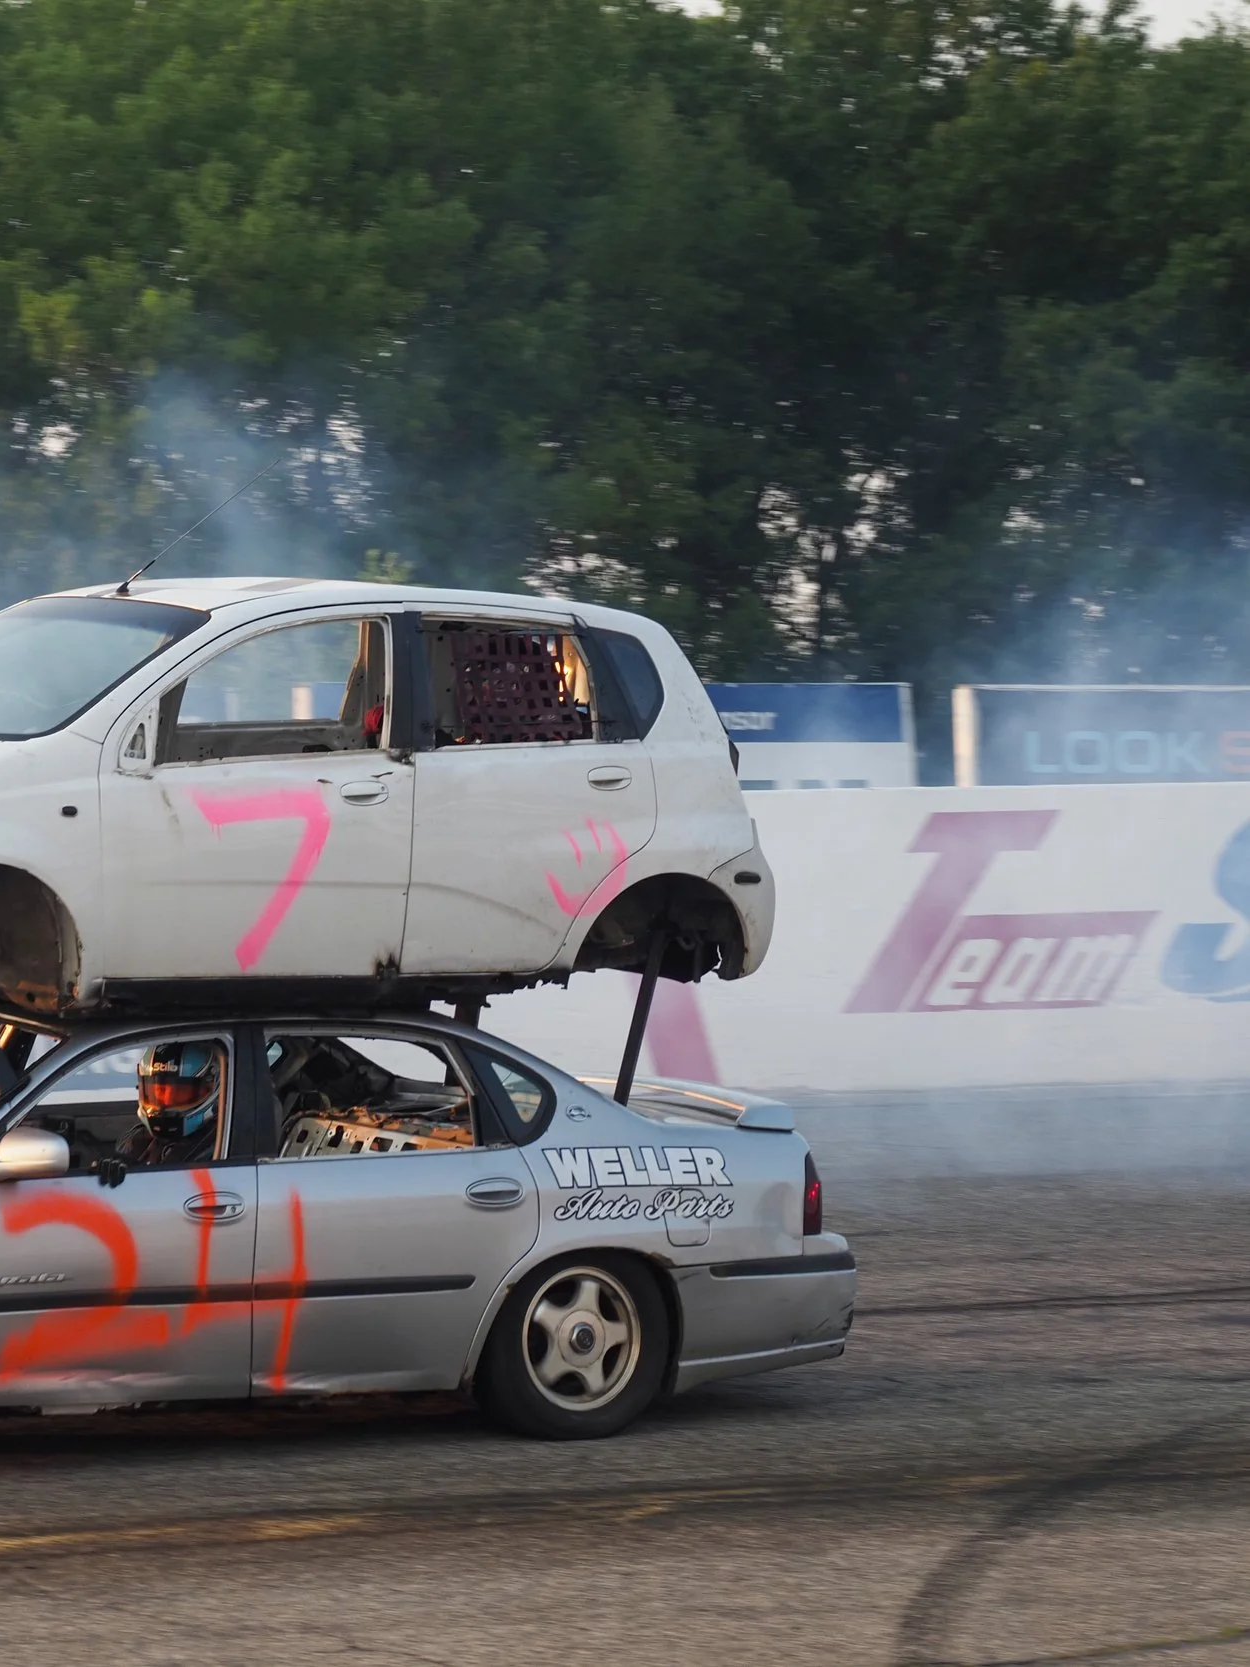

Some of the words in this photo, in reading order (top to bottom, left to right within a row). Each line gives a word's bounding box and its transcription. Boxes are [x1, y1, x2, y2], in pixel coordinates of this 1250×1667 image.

[1024, 730, 1210, 774] LOOK
[190, 786, 332, 973] 7
[541, 1146, 734, 1189] WELLER
[554, 1188, 641, 1221] Auto
[644, 1188, 734, 1221] Parts
